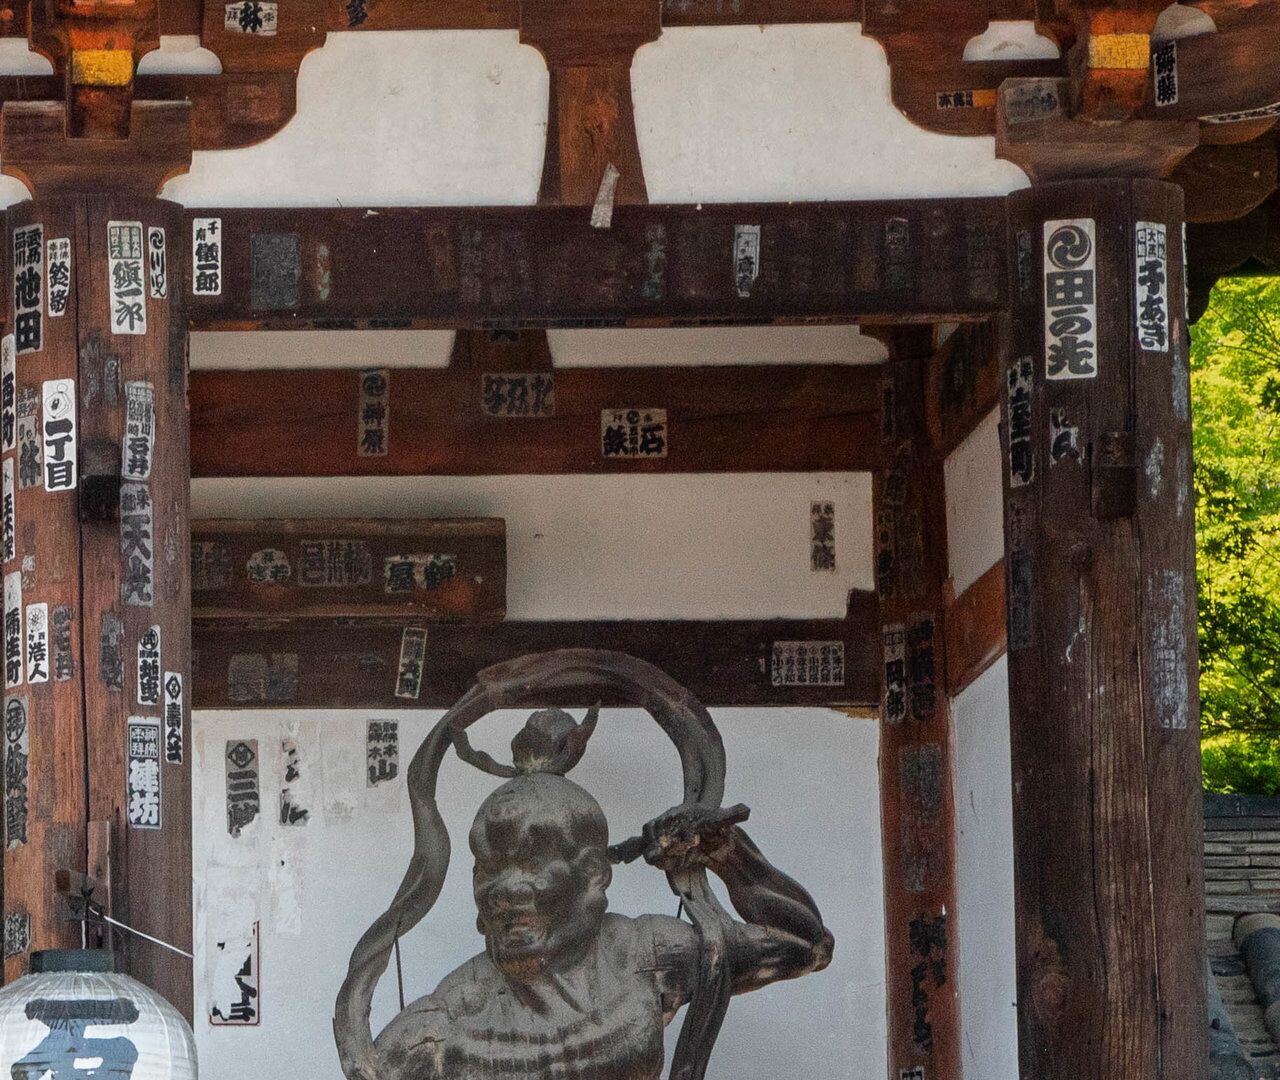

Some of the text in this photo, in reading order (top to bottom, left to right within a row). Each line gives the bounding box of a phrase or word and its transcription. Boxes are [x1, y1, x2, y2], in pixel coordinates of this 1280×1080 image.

[16, 266, 42, 353] 池田
[45, 418, 74, 489] 一丁目
